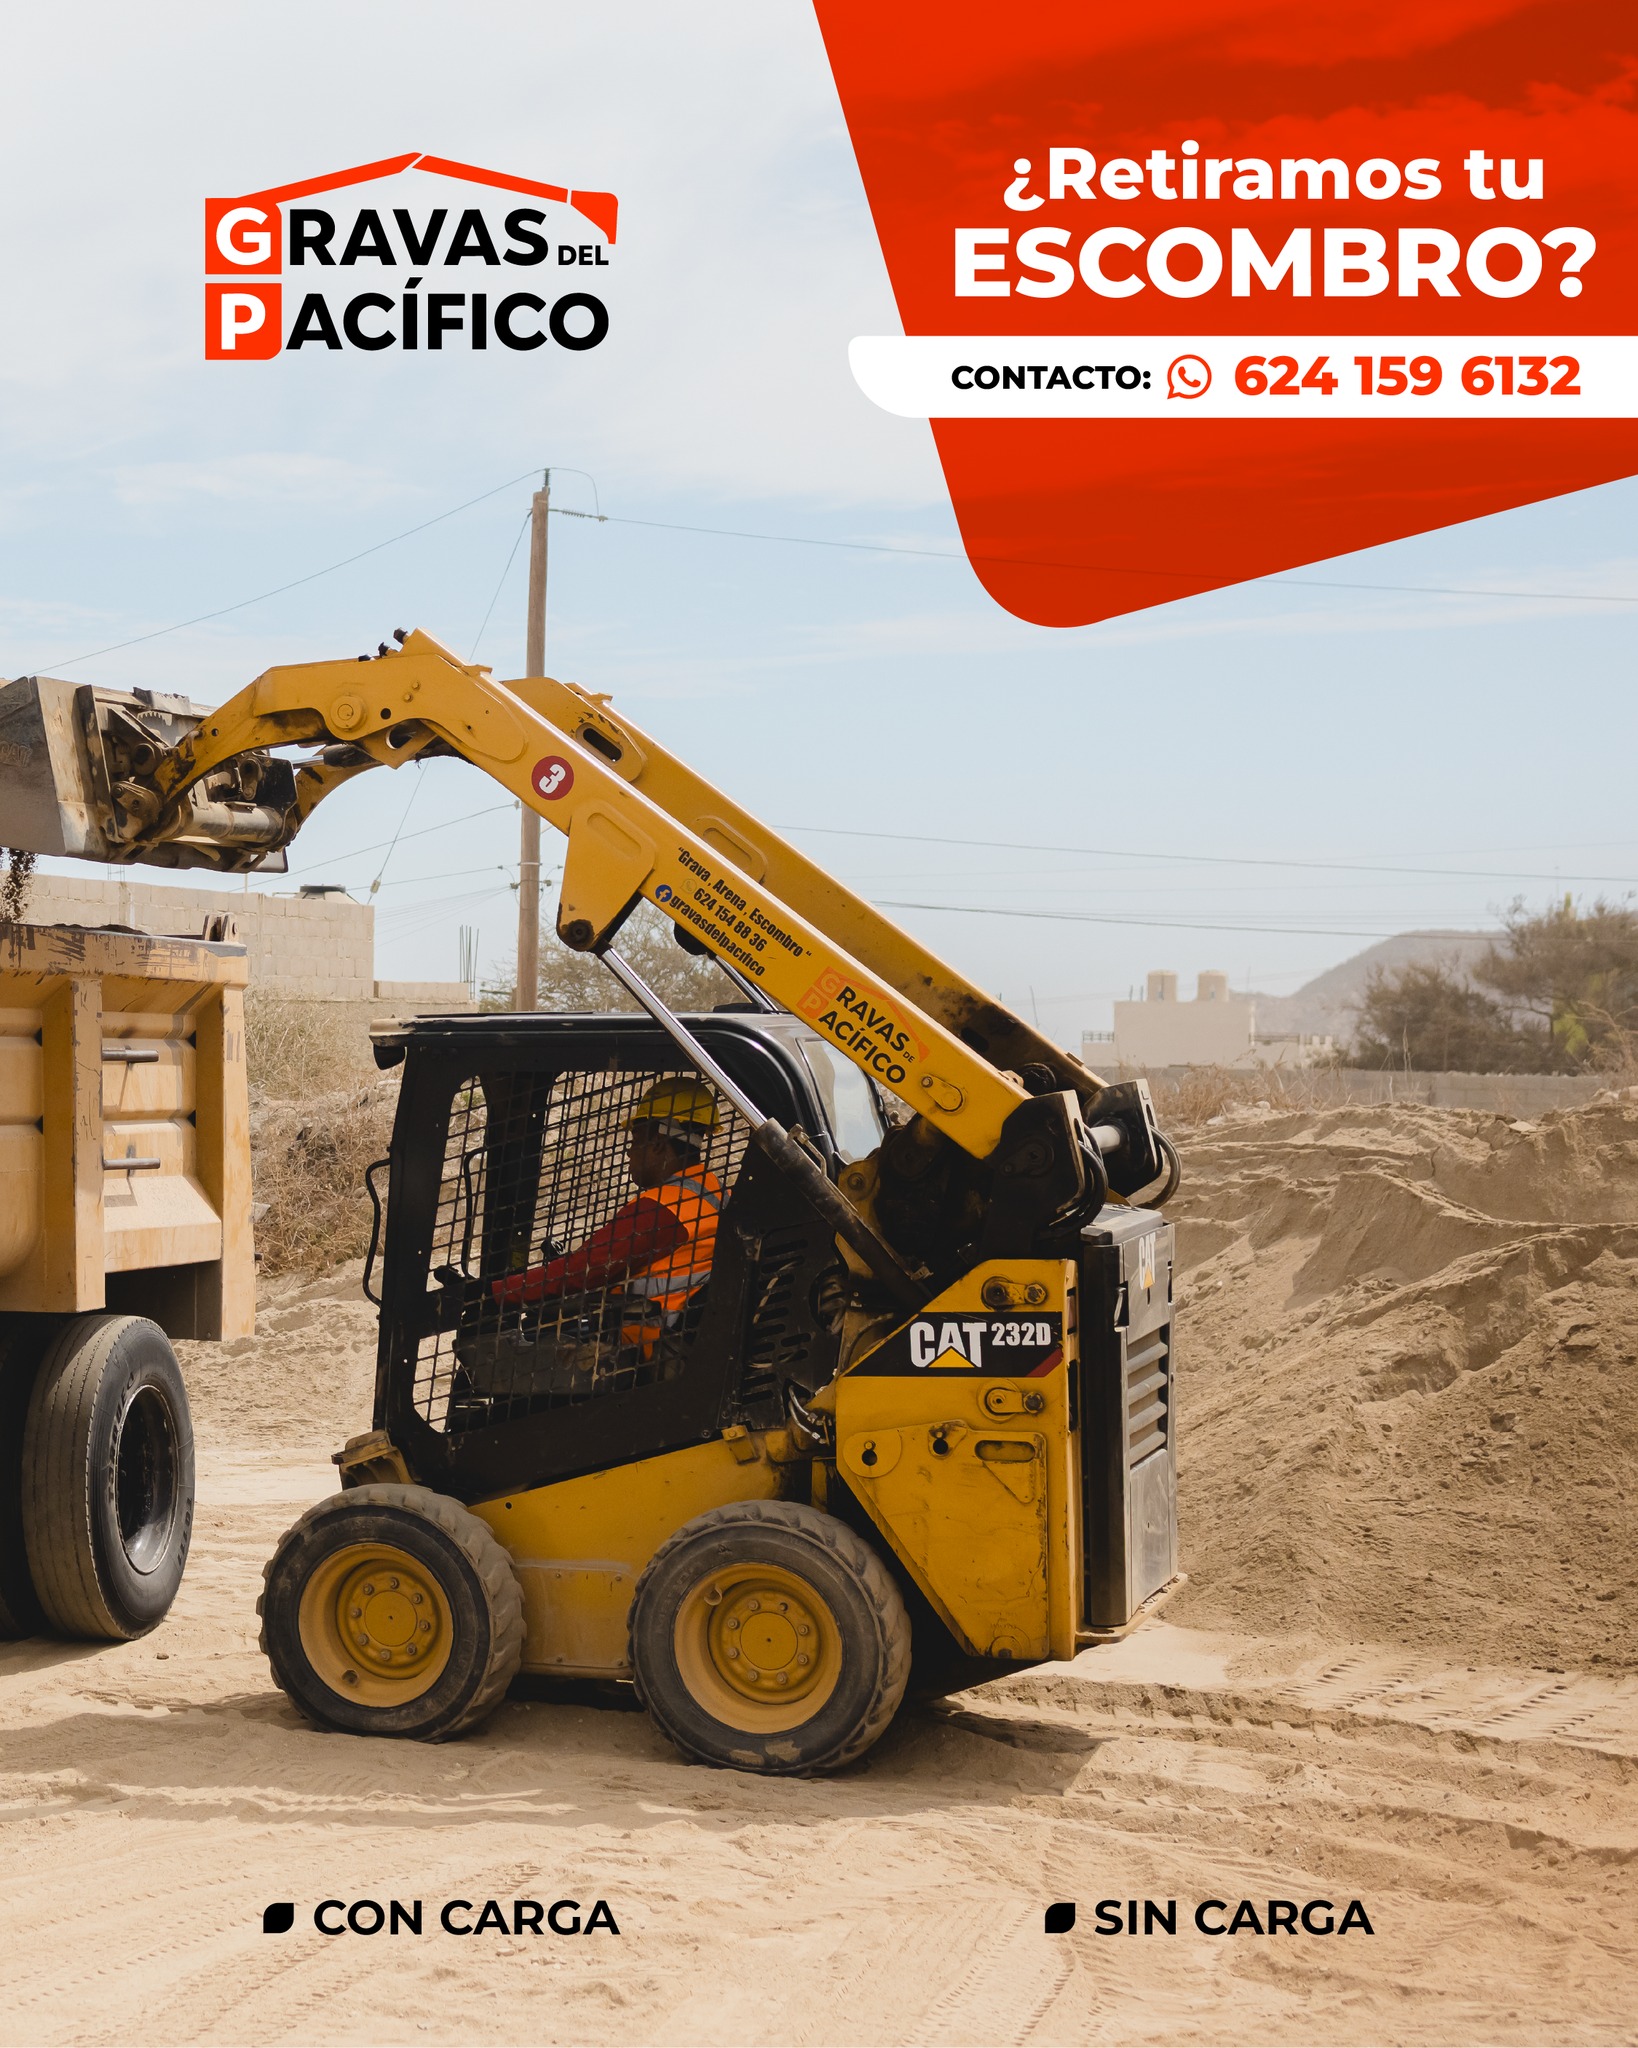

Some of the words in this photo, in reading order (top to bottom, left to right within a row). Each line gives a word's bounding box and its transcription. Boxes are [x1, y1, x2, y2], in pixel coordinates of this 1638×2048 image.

[539, 763, 566, 794] 3
[693, 887, 718, 911] 624
[714, 904, 738, 927] 154
[733, 920, 752, 939] 88
[748, 932, 768, 952] 36
[801, 993, 906, 1084] PACÍFICO
[820, 973, 910, 1052] GRAVAS
[1138, 1231, 1157, 1291] CAT
[909, 1321, 988, 1368] CAT
[991, 1322, 1051, 1346] 232D
